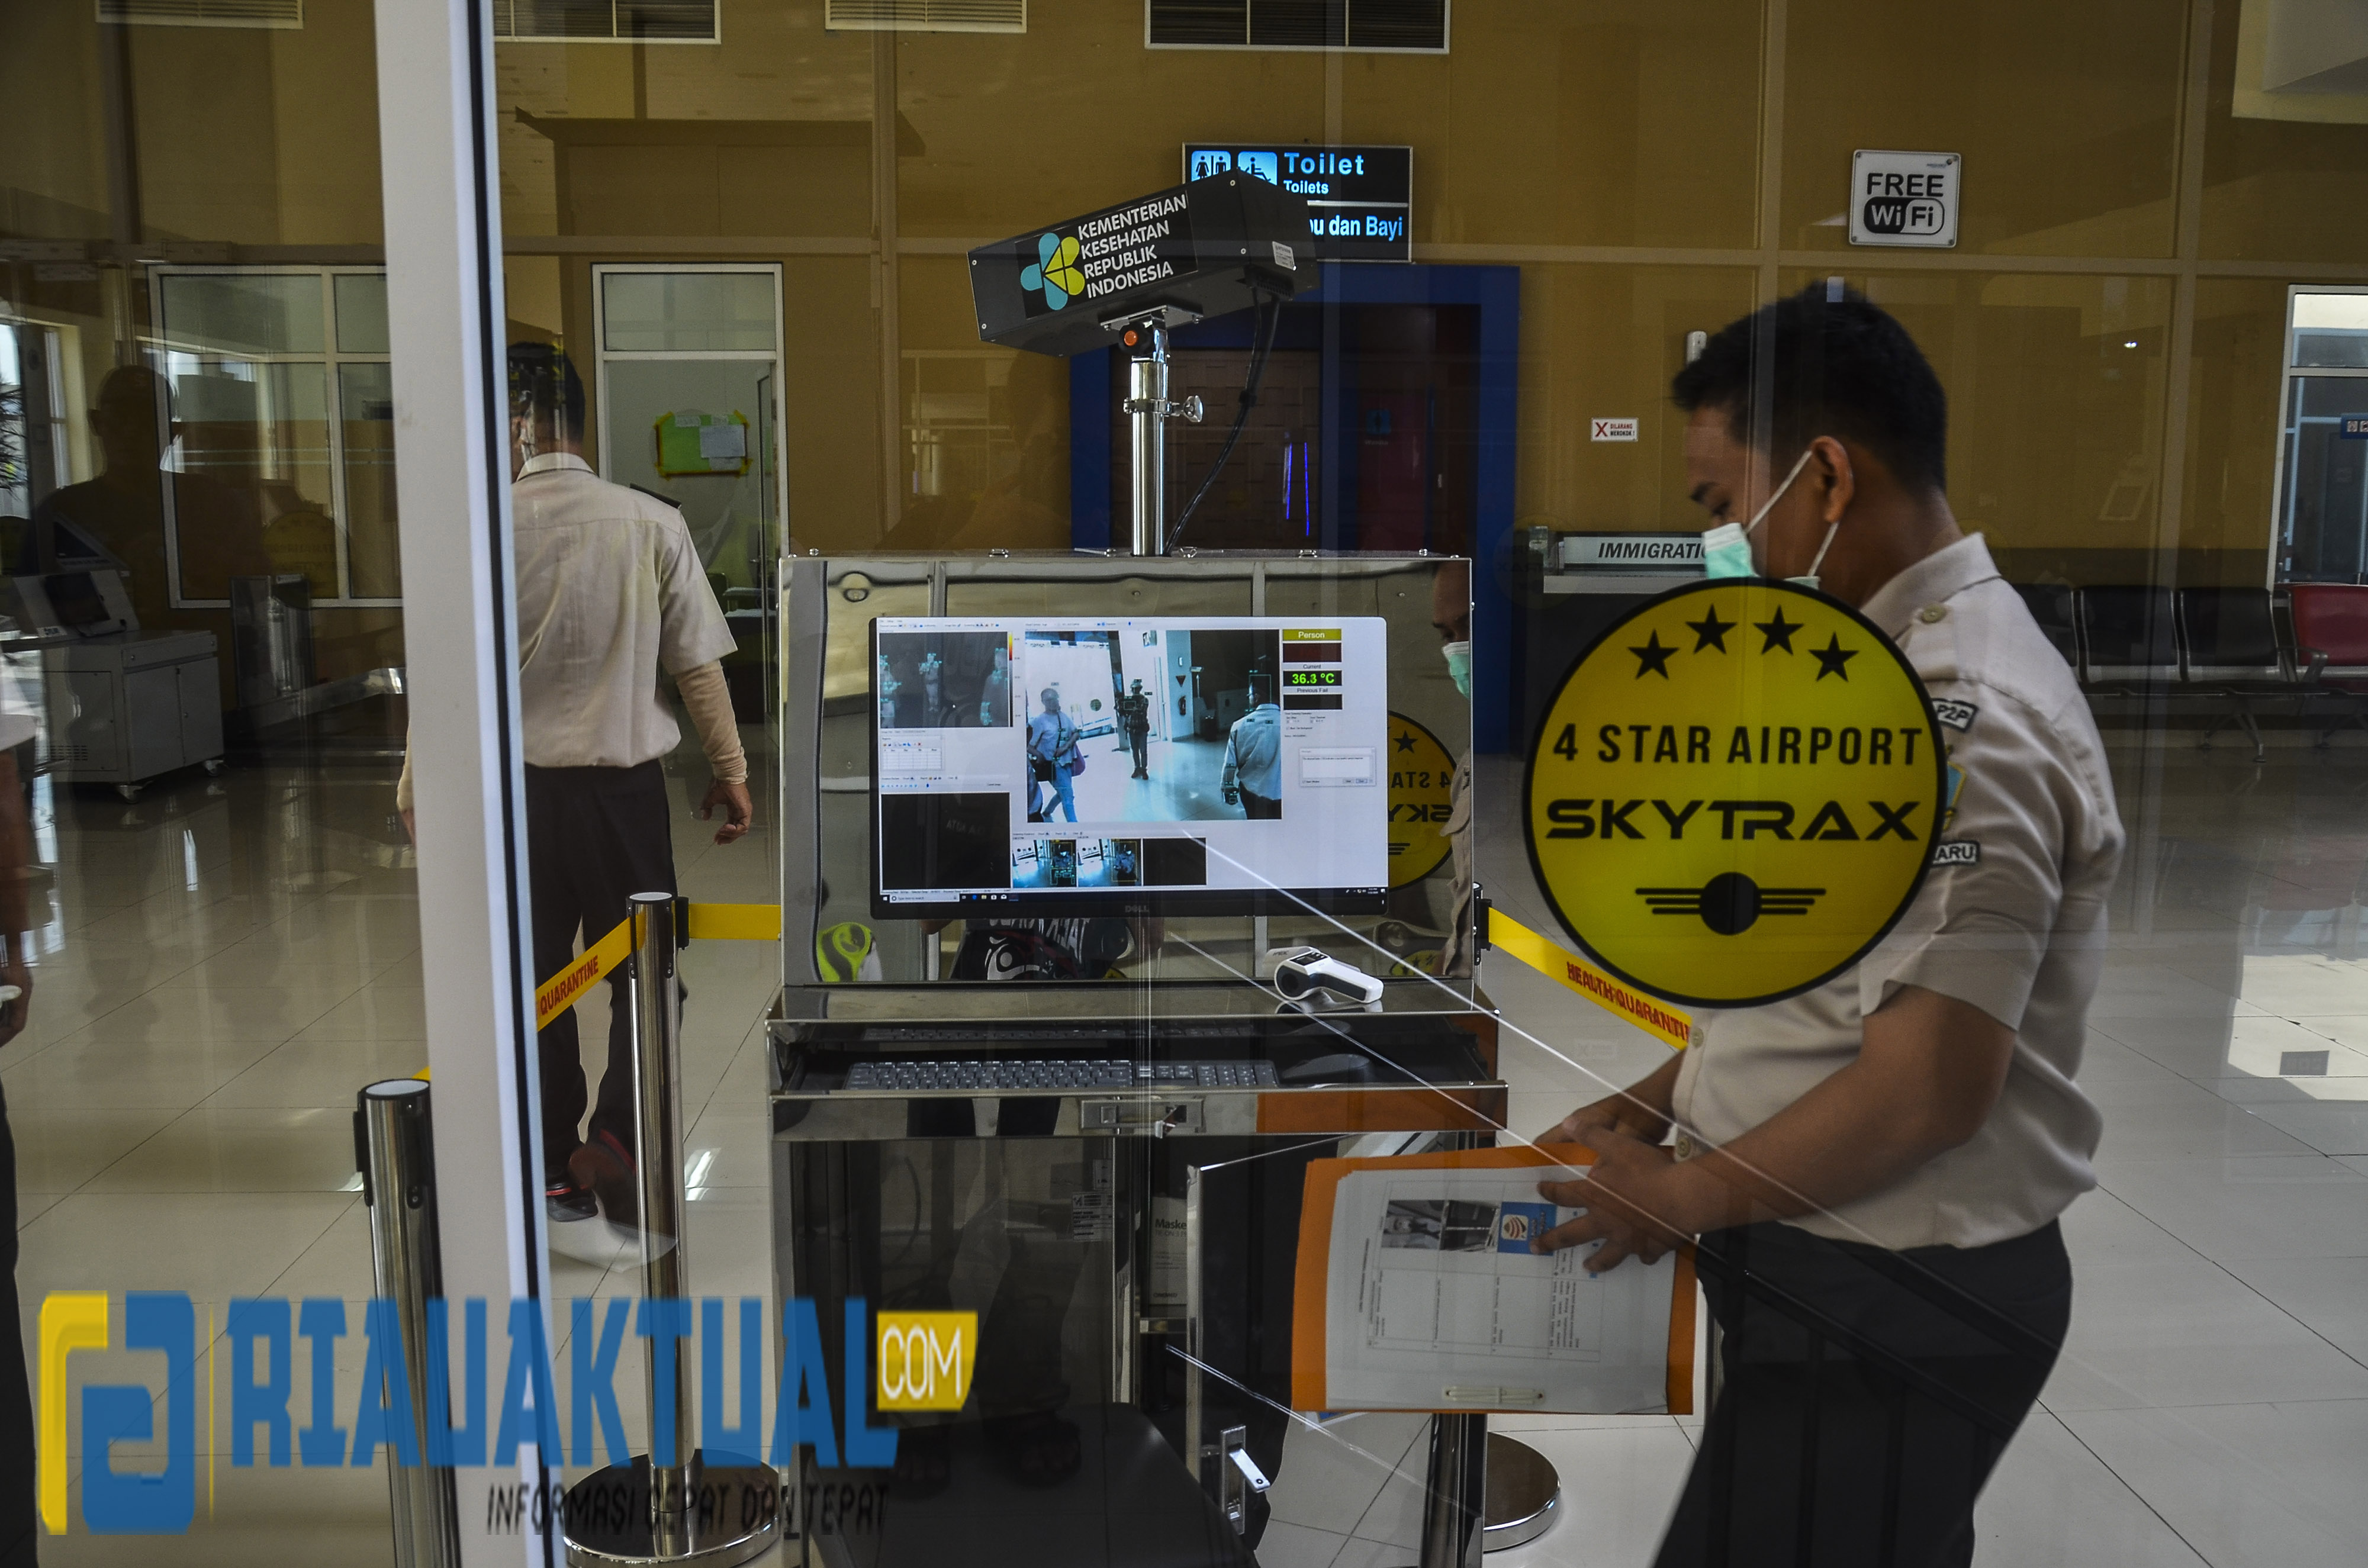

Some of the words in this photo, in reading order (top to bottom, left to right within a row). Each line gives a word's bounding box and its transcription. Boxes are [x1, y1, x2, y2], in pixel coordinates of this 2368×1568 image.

[1284, 152, 1364, 175] Toilet
[1283, 180, 1329, 194] Toilets
[1867, 172, 1944, 197] FREE
[1078, 194, 1186, 240] KEMENTERIAN
[1328, 214, 1360, 236] dan
[1366, 215, 1402, 242] Bayi
[1081, 220, 1170, 259] KESEHATAN
[1084, 244, 1157, 279] REPUBLIK
[1087, 261, 1173, 298] INDONESIA
[1292, 674, 1317, 684] 36.3
[1320, 673, 1334, 684] °C
[1552, 723, 1579, 761] 4
[1598, 725, 1711, 764] STAR
[1726, 726, 1923, 765] AIRPORT
[1545, 799, 1921, 841] SKYTRAX
[1937, 846, 1973, 859] ARU
[540, 955, 599, 1015] QUARANTINE
[1567, 961, 1615, 1003] HEALTH
